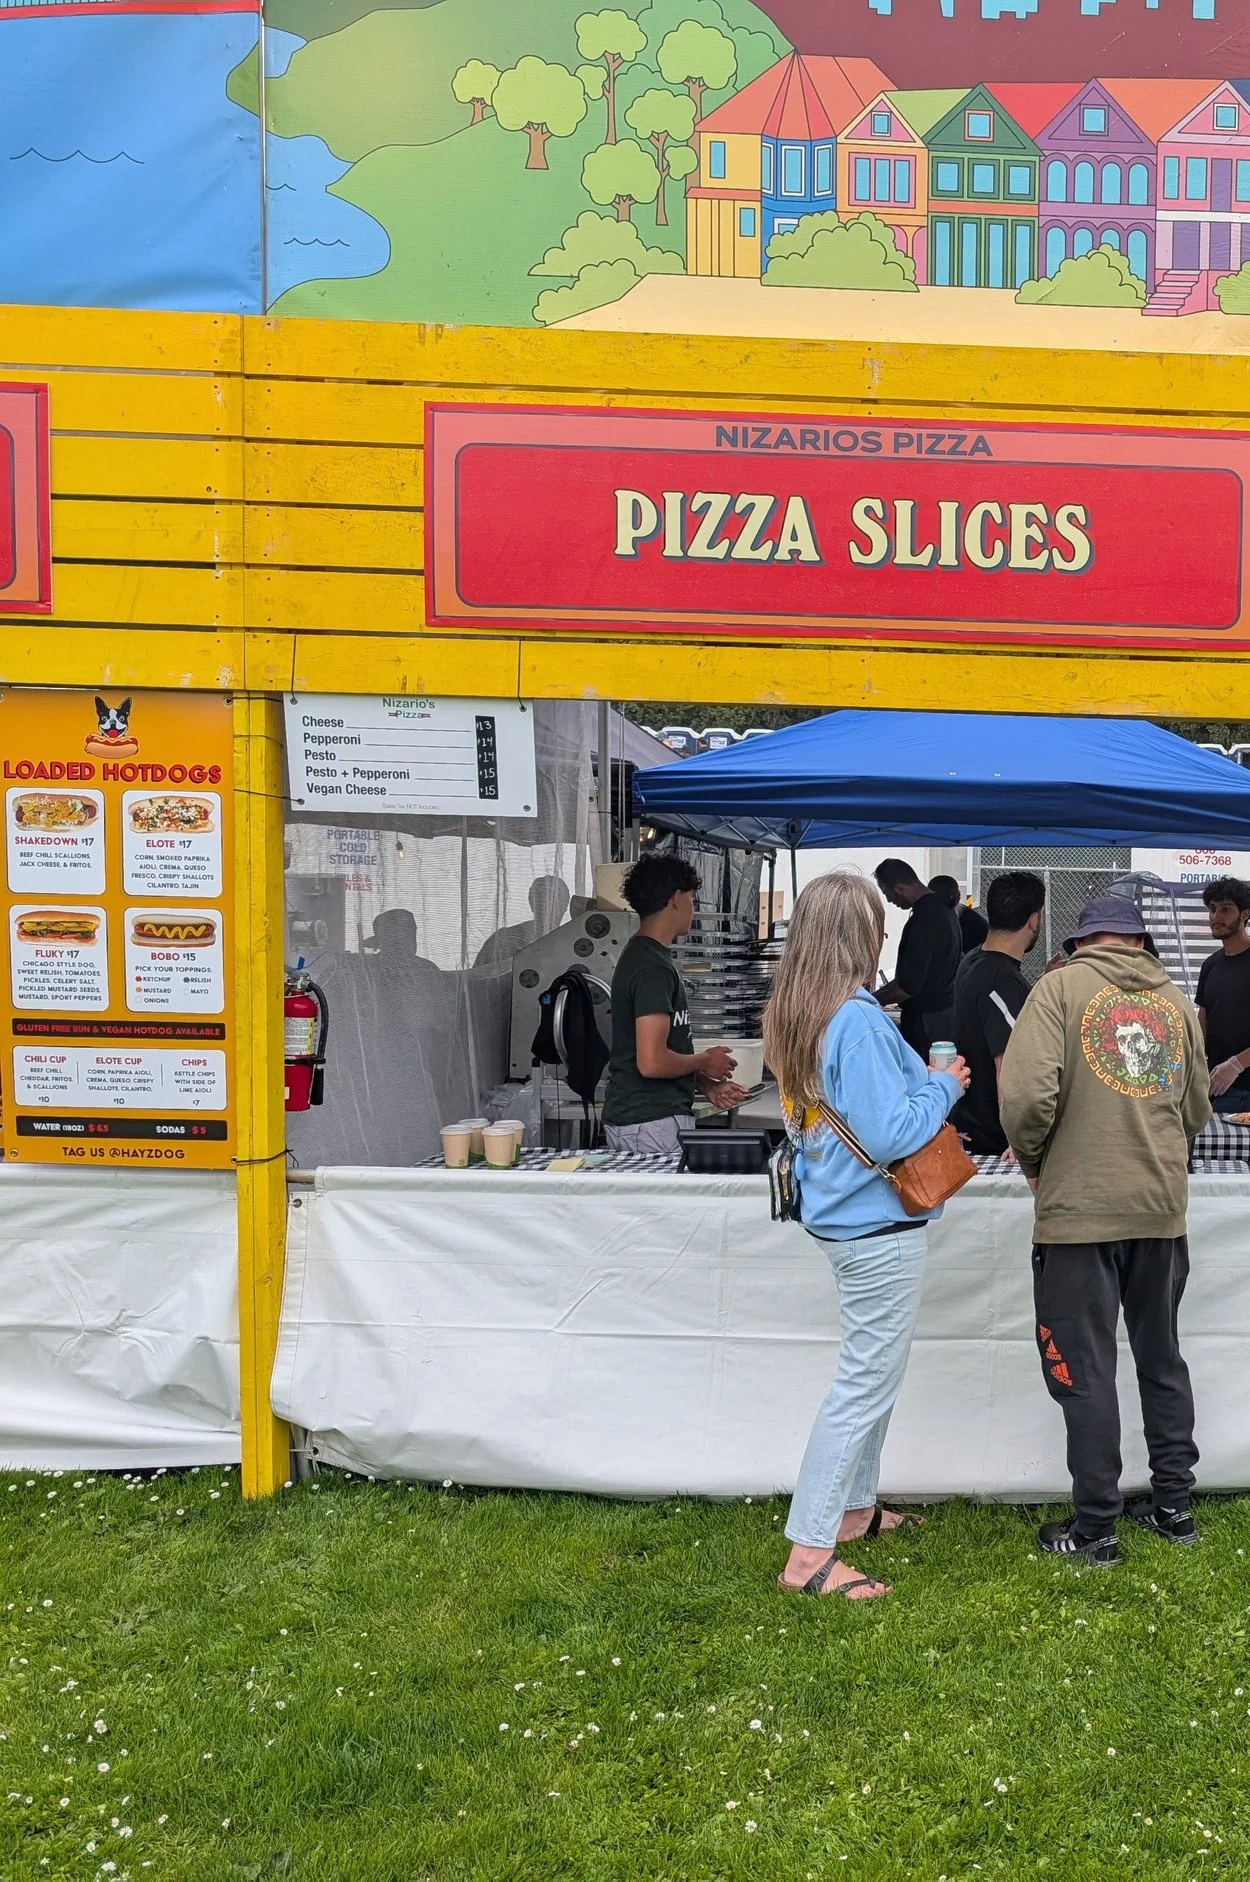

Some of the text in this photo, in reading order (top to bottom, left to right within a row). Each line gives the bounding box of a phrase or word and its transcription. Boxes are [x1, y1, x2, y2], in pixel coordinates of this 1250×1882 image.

[716, 425, 993, 457] NIZARIOS PIZZA
[613, 488, 1094, 573] PIZZA SLICES
[382, 698, 435, 709] Nizario's
[395, 710, 424, 719] Pizza
[302, 715, 344, 728] Cheese
[303, 732, 361, 746] Pepperoni
[304, 749, 336, 761] Pesto
[4, 760, 221, 784] LOADED HOTDOGS
[305, 766, 337, 777] Pesto
[353, 767, 410, 781] Pepperoni
[306, 782, 342, 796] Vegan
[346, 783, 387, 795] Cheese
[327, 829, 380, 840] PORTABLE
[15, 836, 94, 846] SHAKEDOWN $17
[146, 840, 192, 848] ELOTE $17
[340, 843, 366, 853] COLD
[329, 854, 377, 865] STORAGE
[1178, 855, 1232, 866] 506-7368
[35, 949, 80, 959] FLUKY $17
[151, 952, 196, 961] BOBO $15
[16, 1024, 49, 1032] GLUTEN
[73, 1025, 90, 1033] BUN
[92, 1025, 99, 1033] &
[101, 1026, 131, 1034] VEGAN
[134, 1026, 173, 1035] HOTDOG
[175, 1028, 220, 1036] AVAILABLE
[24, 1055, 47, 1063] CHILI
[181, 1059, 207, 1067] CHIPS
[33, 1122, 61, 1131] WATER
[156, 1126, 186, 1134] SODAS
[62, 1147, 185, 1159] TAG US @HAYZDOG
